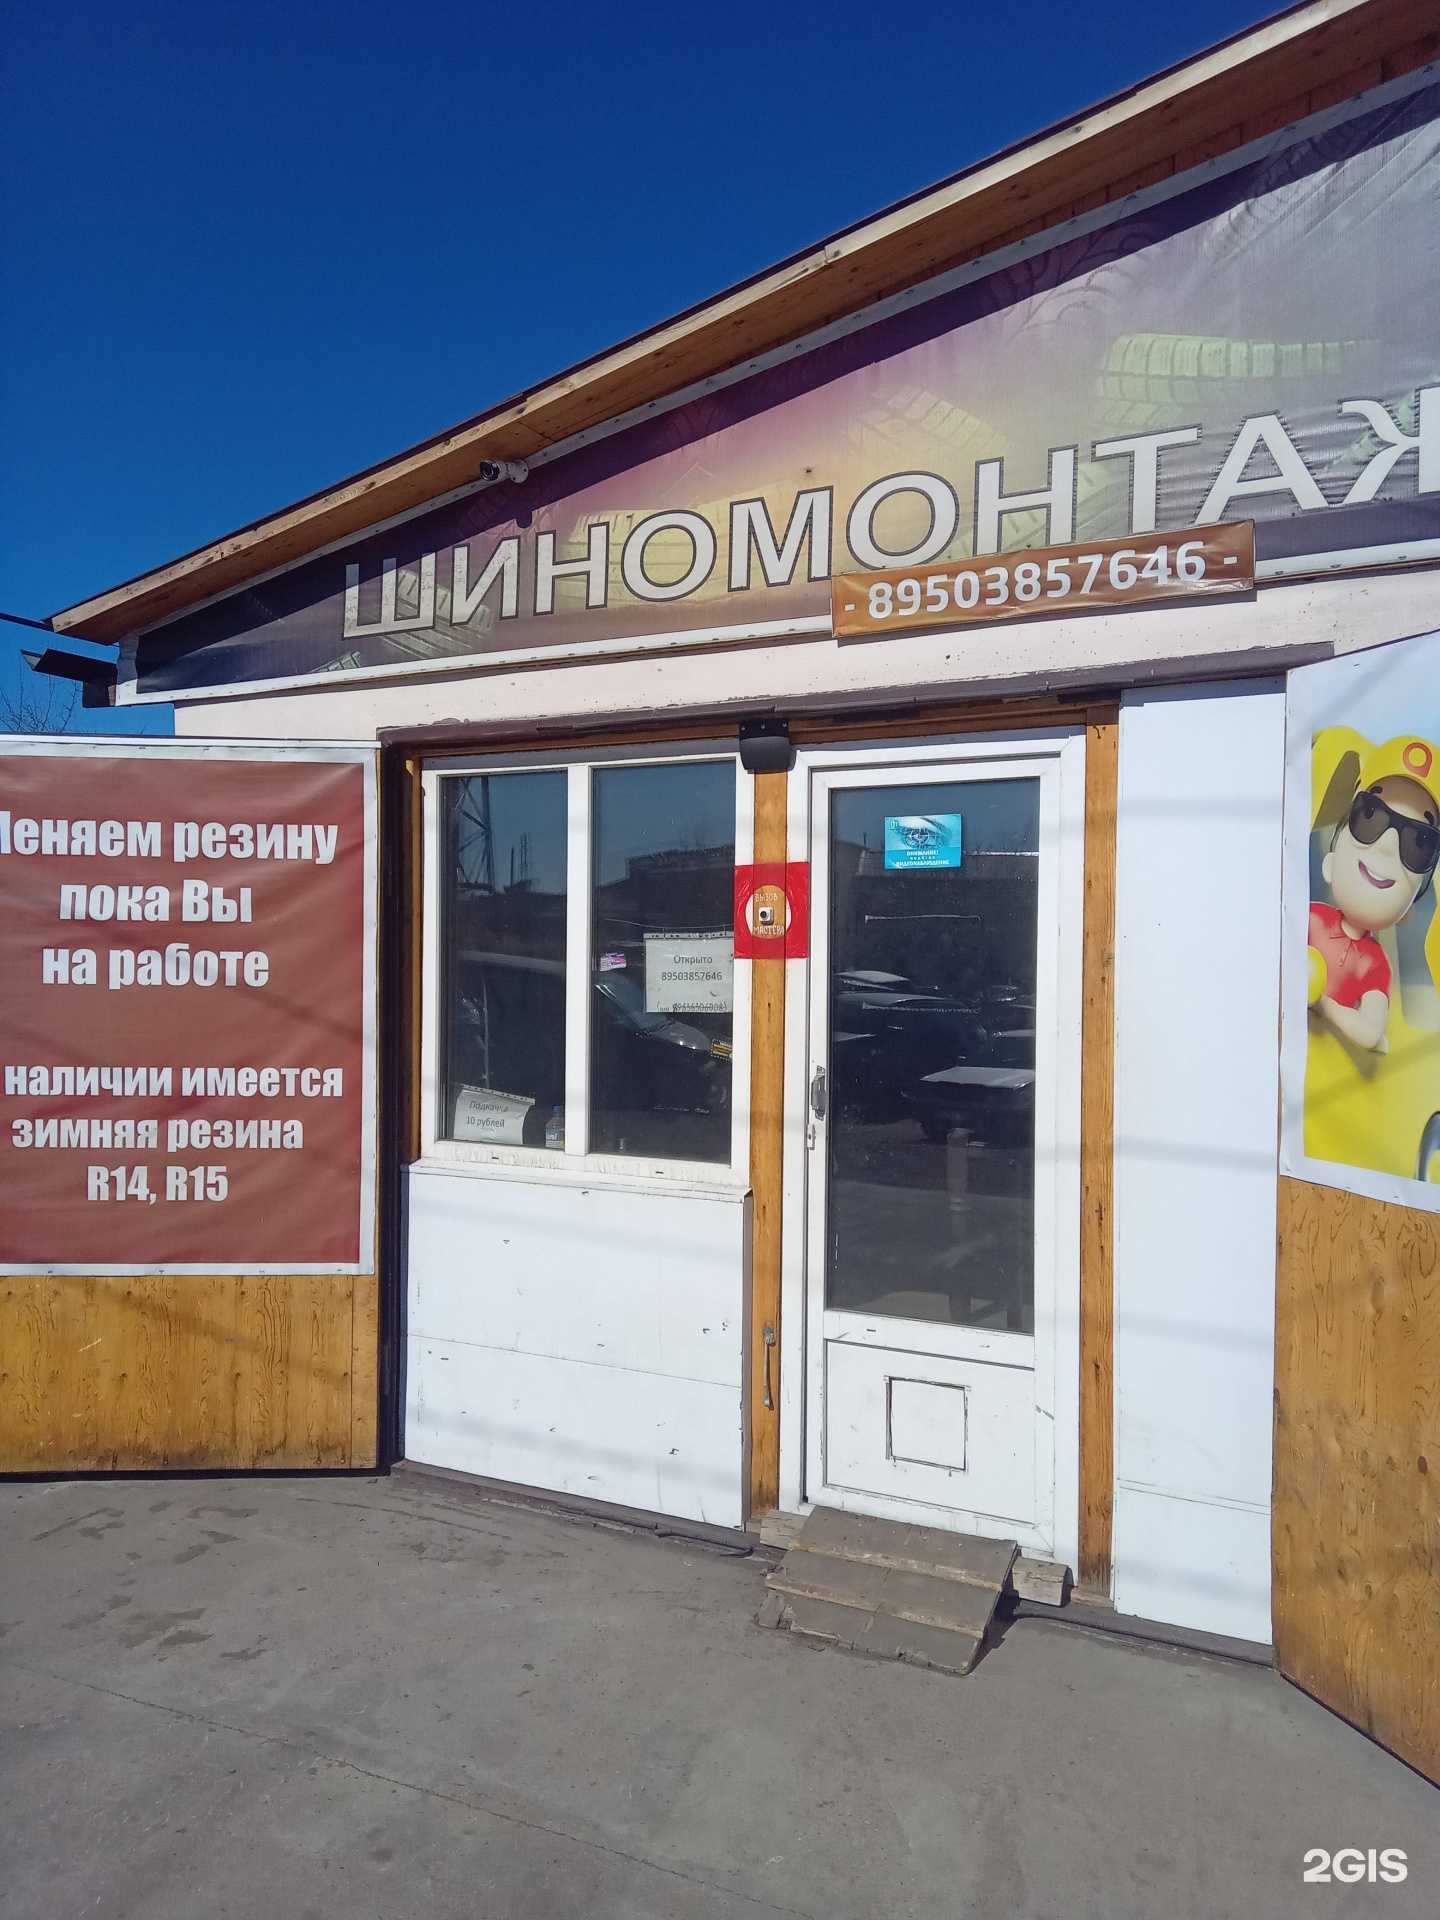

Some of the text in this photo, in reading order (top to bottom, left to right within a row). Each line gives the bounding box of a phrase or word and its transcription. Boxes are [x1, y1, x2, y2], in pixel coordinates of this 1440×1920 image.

[867, 541, 1207, 620] 89503857646
[173, 821, 338, 865] резину
[59, 879, 252, 922] пока Вы
[42, 942, 269, 990] на работе
[661, 971, 723, 982] 89503857646
[673, 954, 713, 966] Открыто
[4, 1065, 344, 1097] наличии имеется
[11, 1118, 304, 1152] зимняя резина
[466, 1115, 505, 1129] 10 рублей
[87, 1165, 229, 1205] R14, R15
